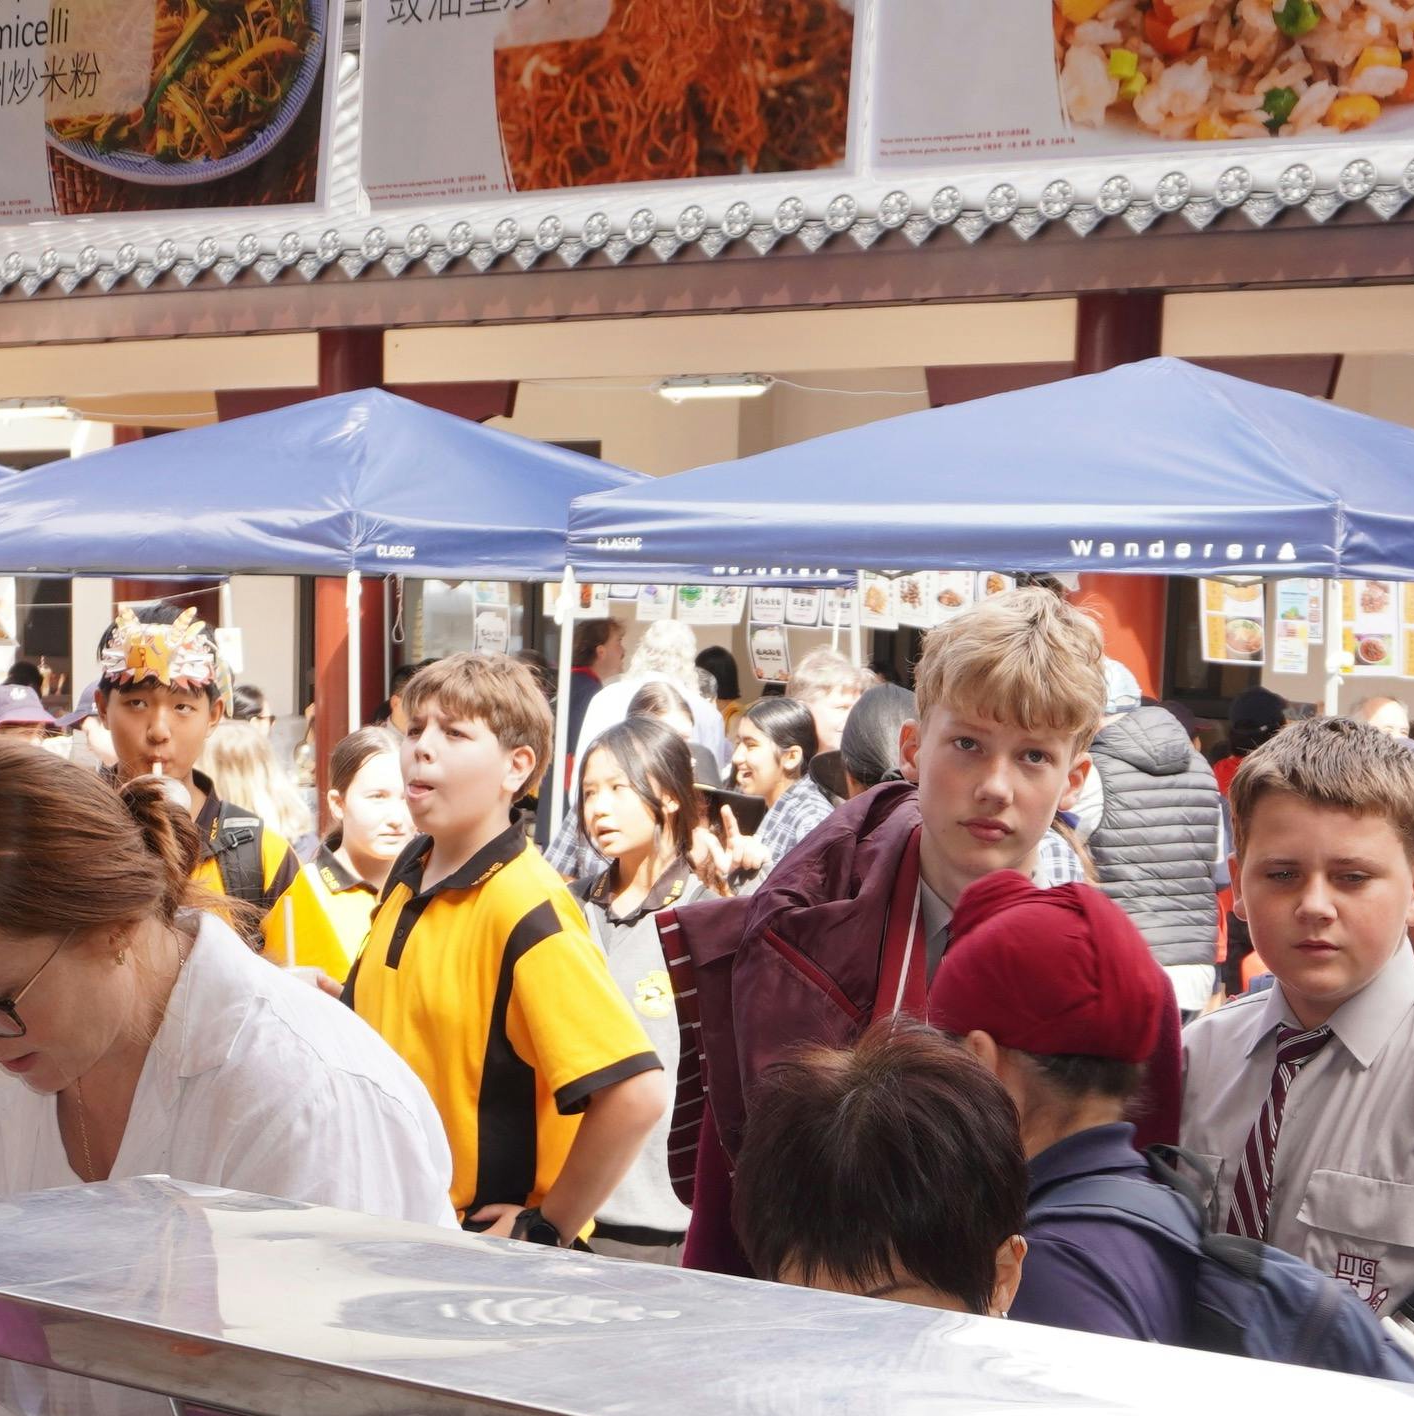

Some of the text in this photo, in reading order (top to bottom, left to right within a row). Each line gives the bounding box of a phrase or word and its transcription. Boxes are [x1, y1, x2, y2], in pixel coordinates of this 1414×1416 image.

[375, 544, 416, 559] CLASSIC
[596, 537, 643, 551] CLASSIC
[318, 866, 342, 891] KSHS
